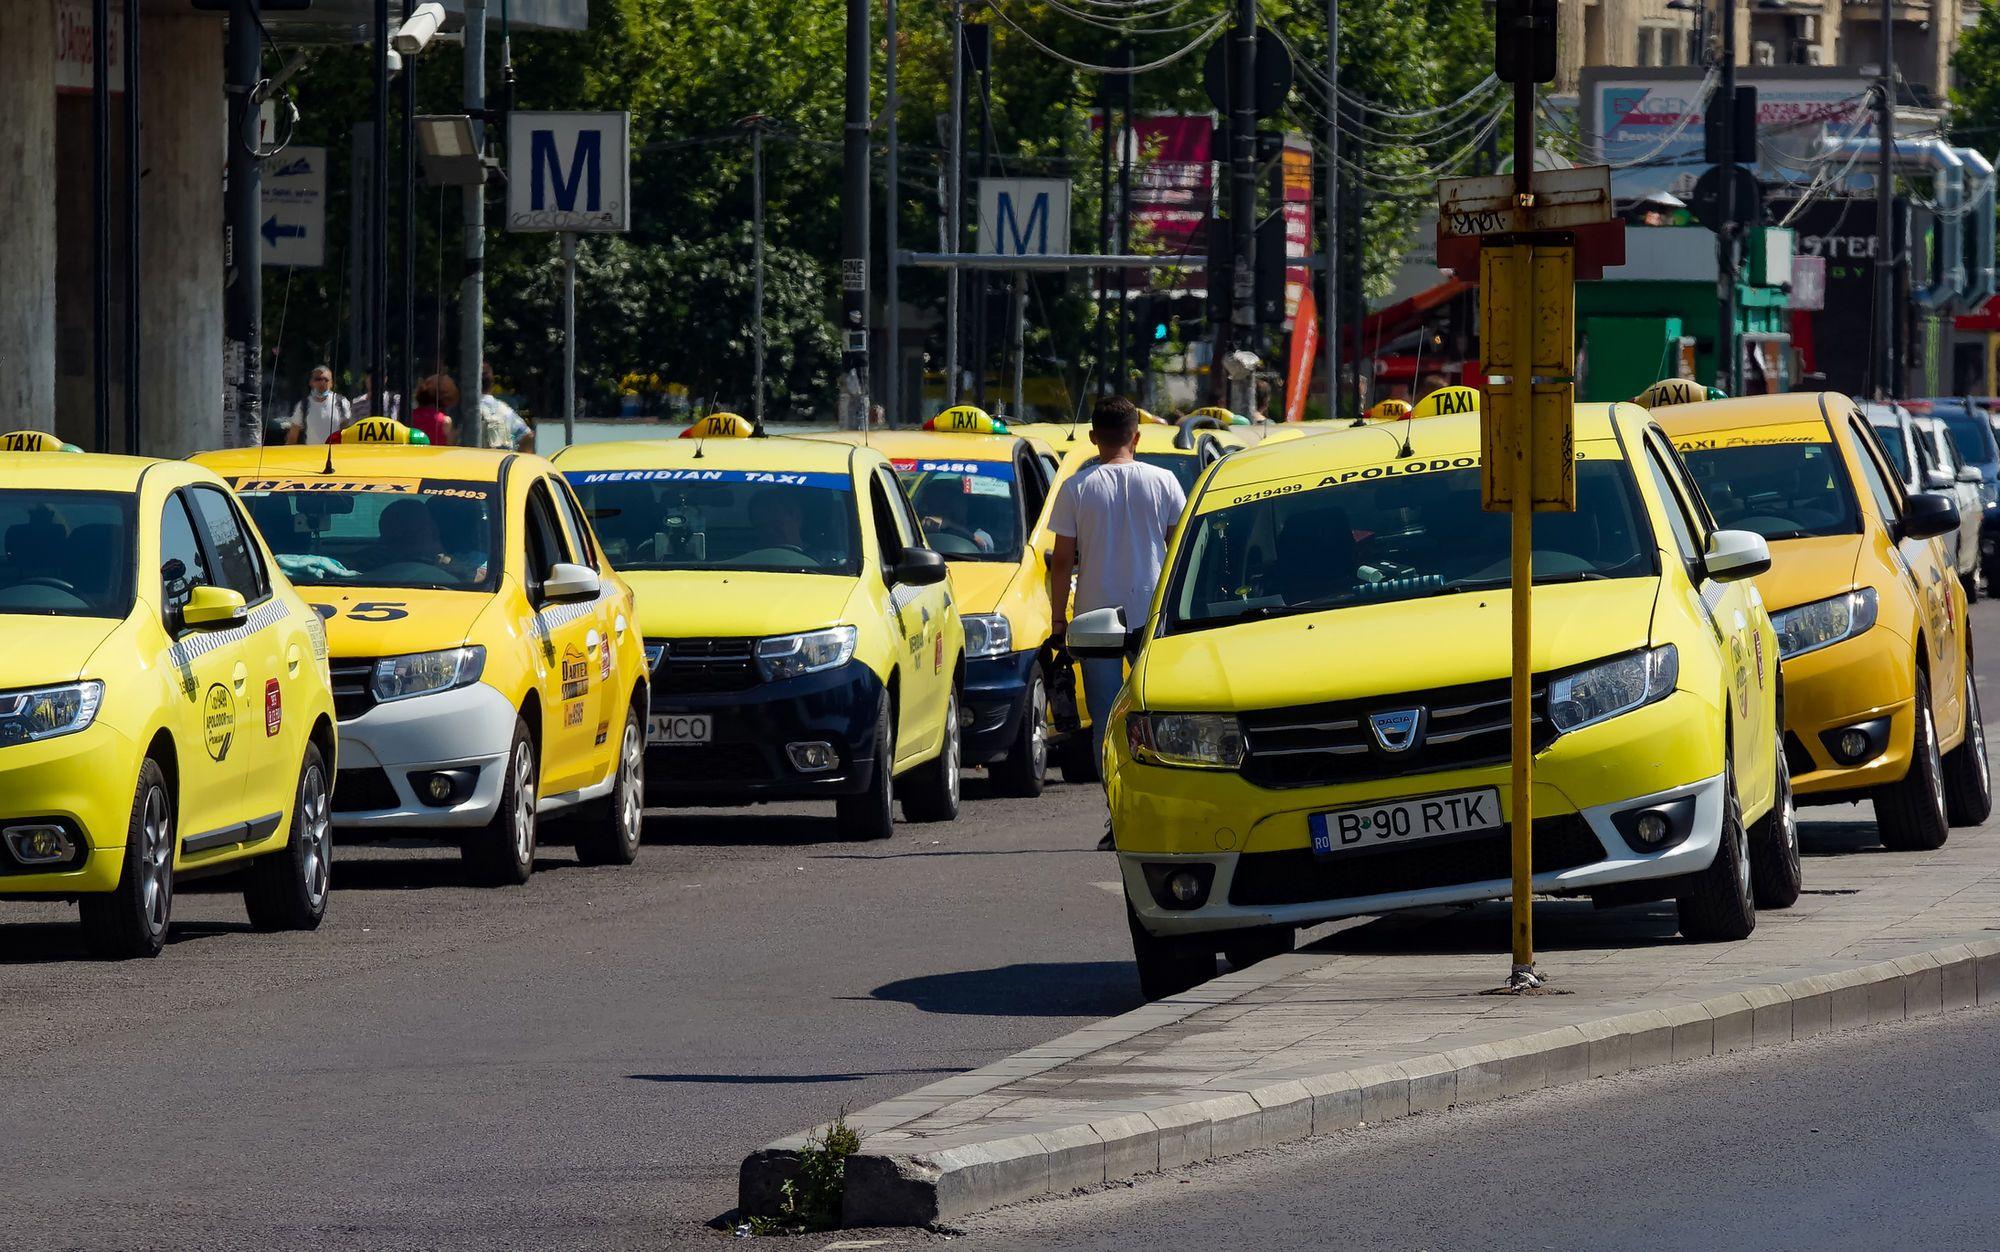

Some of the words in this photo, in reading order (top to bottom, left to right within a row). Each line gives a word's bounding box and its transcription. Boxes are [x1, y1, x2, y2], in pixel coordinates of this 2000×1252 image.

[531, 130, 600, 211] M
[997, 192, 1048, 255] M
[1432, 390, 1474, 415] TAXI
[1648, 384, 1691, 408] TAXI
[1382, 403, 1404, 416] TAXI
[707, 417, 736, 436] TAXI
[951, 411, 977, 429] TAXI
[357, 422, 395, 442] TAXI
[5, 433, 42, 452] TAXI
[1673, 440, 1717, 452] AXI
[584, 471, 722, 482] MERIDIAN
[745, 473, 807, 485] TAXI
[1233, 484, 1302, 506] 0219499
[658, 718, 706, 739] MCO
[1378, 715, 1411, 726] DACIA
[1338, 814, 1362, 844] B
[1374, 807, 1412, 839] 90
[1421, 795, 1489, 833] RTK
[1315, 836, 1329, 849] RO
